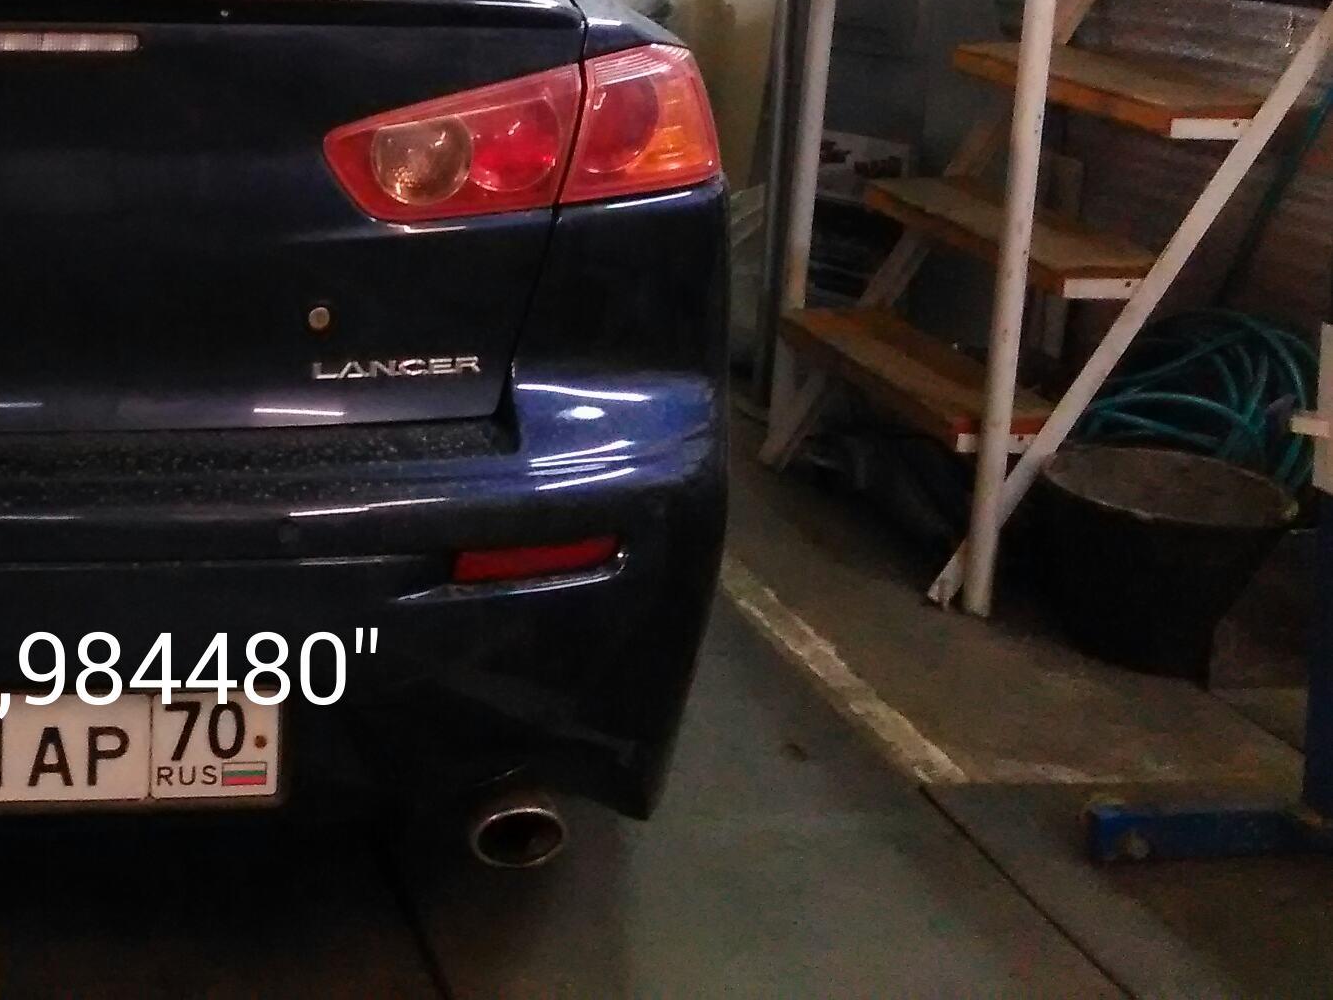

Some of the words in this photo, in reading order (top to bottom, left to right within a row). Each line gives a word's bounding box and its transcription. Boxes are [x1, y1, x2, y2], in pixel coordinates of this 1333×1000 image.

[311, 355, 481, 379] LANCER
[163, 700, 247, 763] 70
[156, 765, 218, 787] RUS
